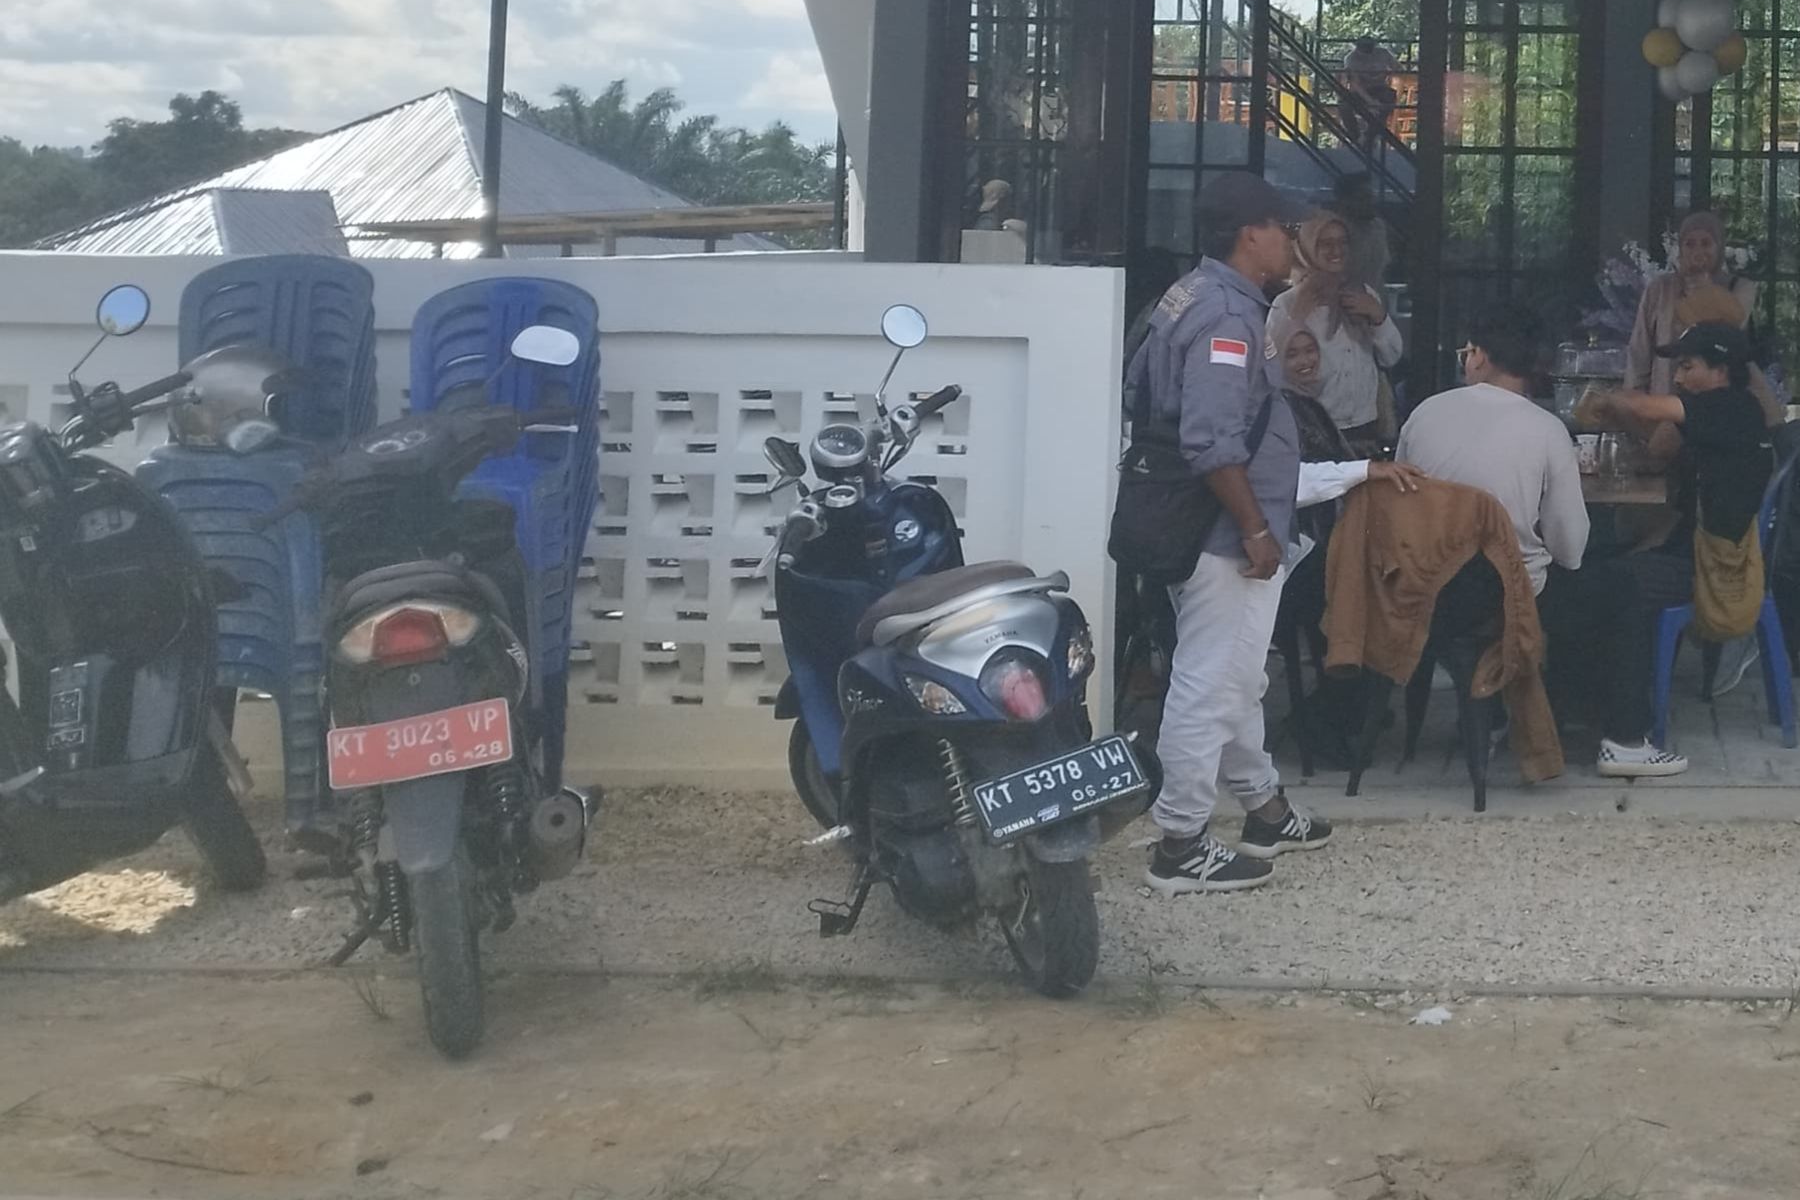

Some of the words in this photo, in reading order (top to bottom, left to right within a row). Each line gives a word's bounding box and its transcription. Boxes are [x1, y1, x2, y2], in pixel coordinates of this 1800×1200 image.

[333, 732, 367, 758] KT
[385, 718, 451, 751] 3023
[467, 707, 499, 733] VP
[980, 782, 1013, 812] KT
[1023, 760, 1083, 795] 5378
[1091, 743, 1126, 770] VW
[1002, 816, 1036, 835] YAMAHA
